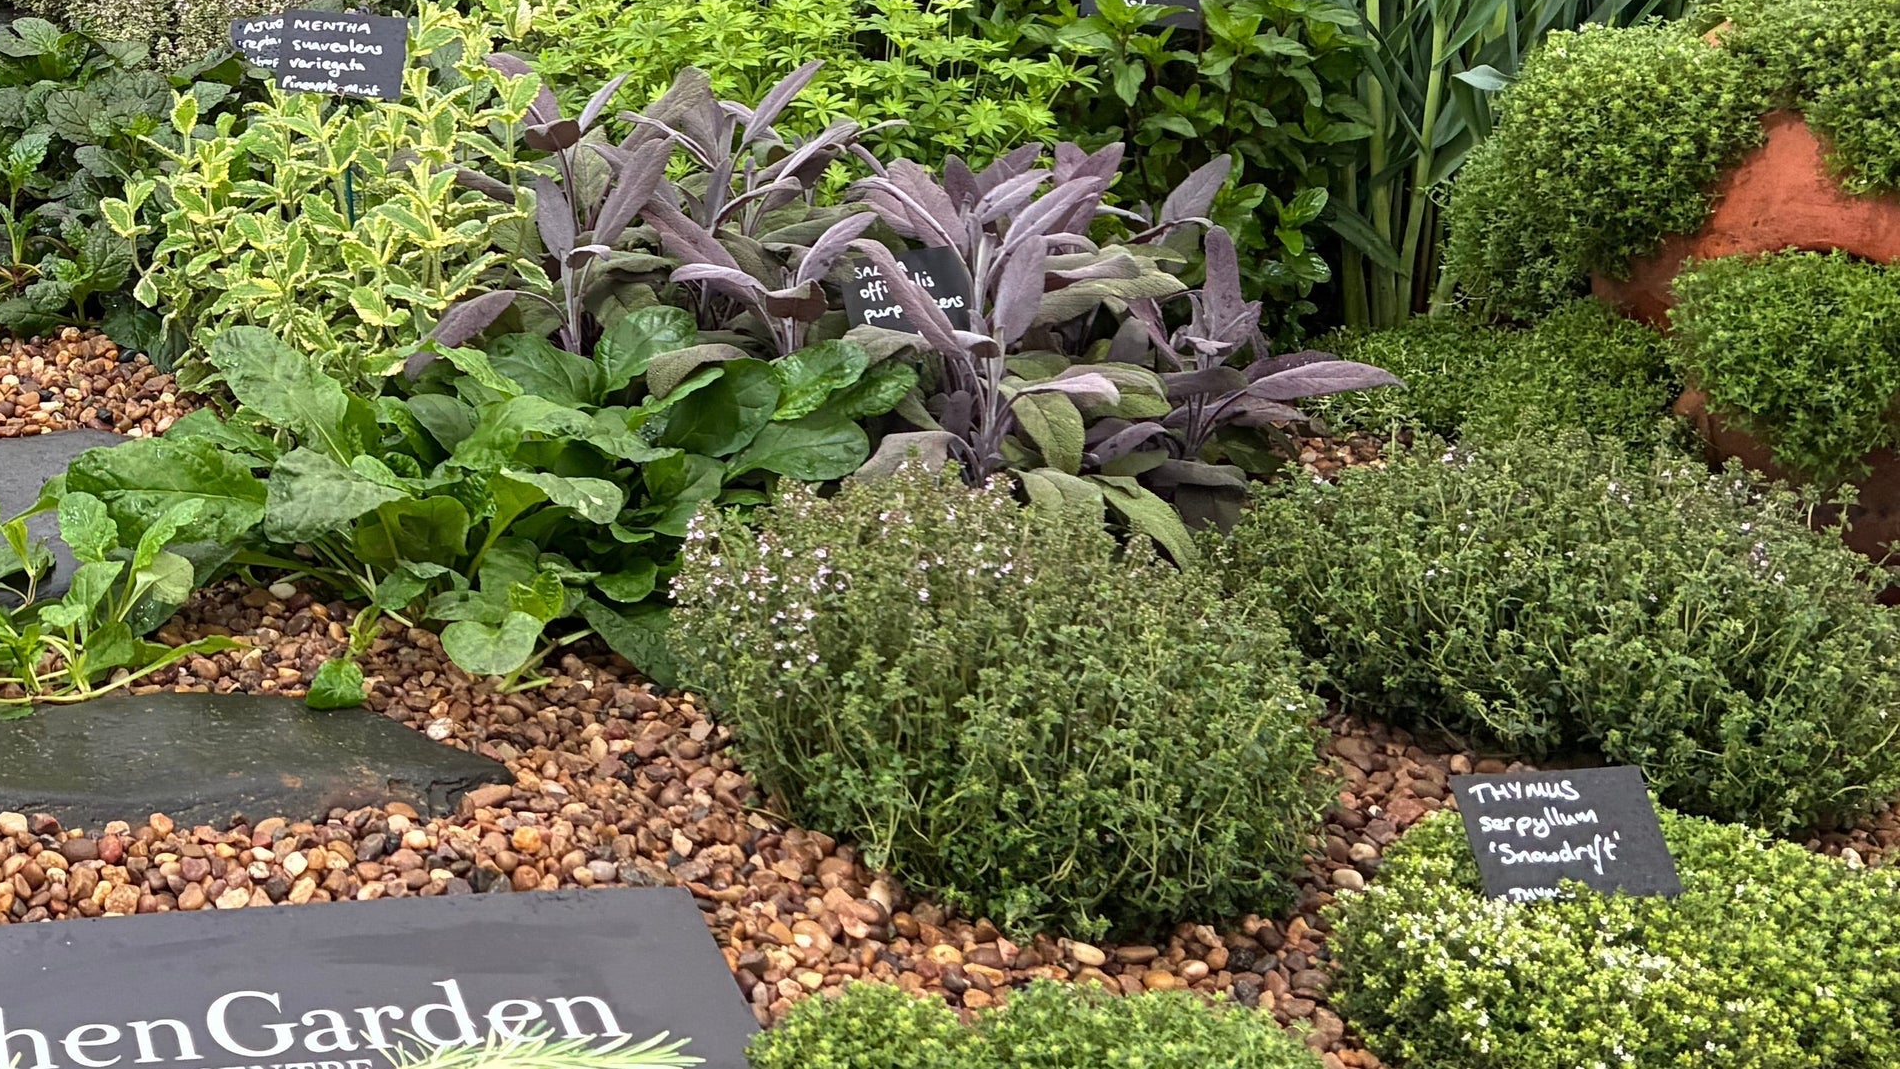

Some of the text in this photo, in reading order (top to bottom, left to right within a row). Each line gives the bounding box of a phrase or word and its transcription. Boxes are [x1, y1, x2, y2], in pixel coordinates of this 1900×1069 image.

[293, 19, 372, 35] MENTHA
[292, 39, 383, 55] suaveolens
[1468, 780, 1581, 804] THYMUS
[1478, 807, 1599, 838] serpyllum
